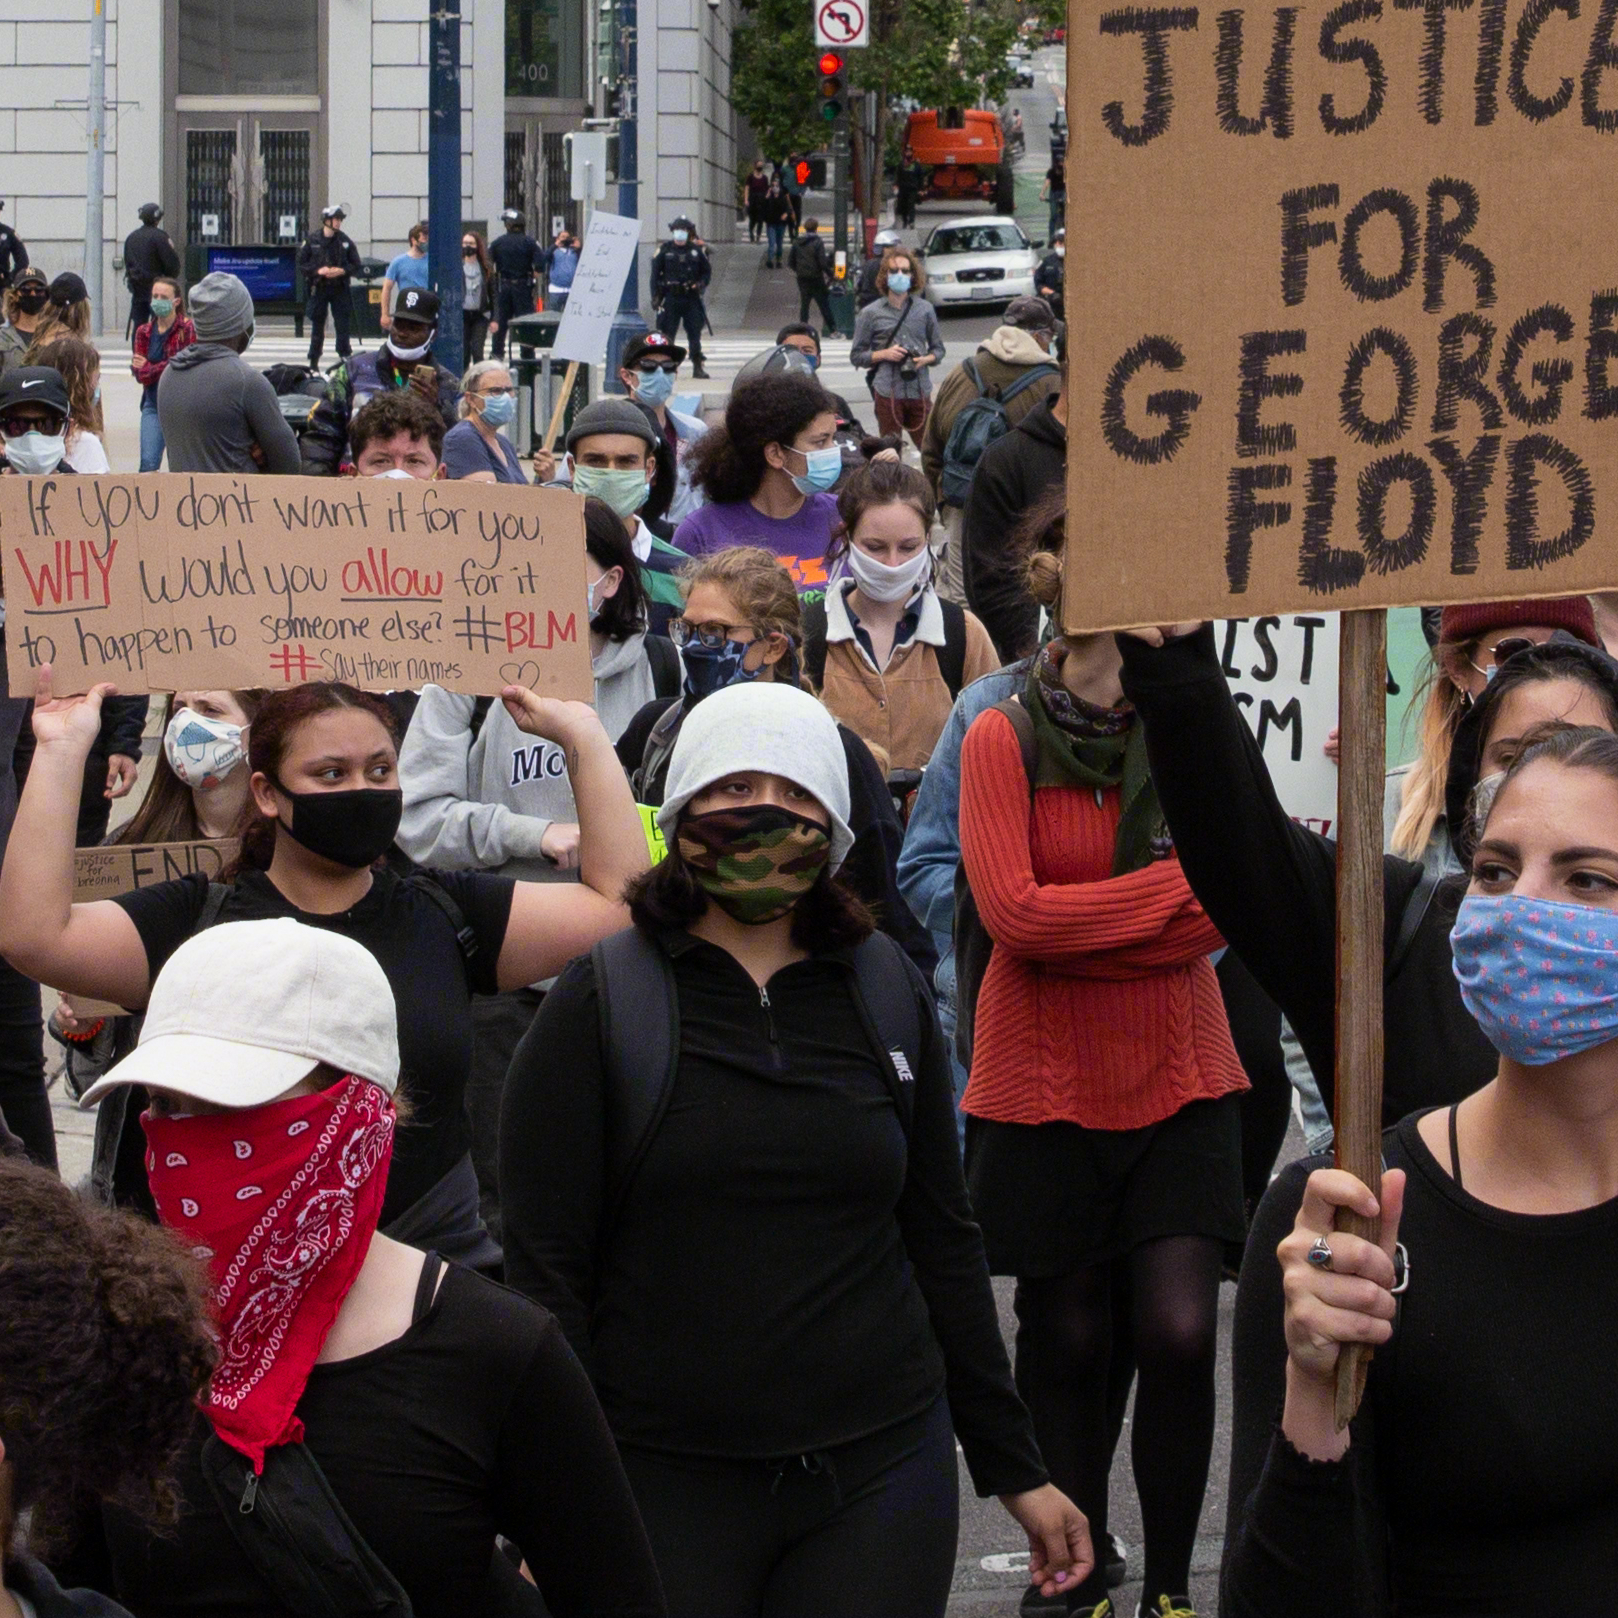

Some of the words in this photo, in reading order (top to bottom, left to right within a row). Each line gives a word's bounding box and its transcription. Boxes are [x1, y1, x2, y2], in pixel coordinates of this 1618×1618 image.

[1278, 174, 1499, 314] FOR
[27, 480, 58, 537] If
[77, 480, 159, 559] you
[176, 476, 260, 531] don't
[274, 491, 371, 531] want
[385, 491, 408, 532] it
[416, 488, 468, 535] for
[478, 508, 544, 570] you,
[1224, 432, 1598, 595] FLOYD
[14, 538, 119, 607] WHY
[139, 539, 257, 604] would
[264, 562, 328, 622] you
[341, 546, 444, 597] allow
[453, 557, 505, 596] for
[509, 560, 539, 595] it
[19, 625, 57, 668] to
[74, 617, 194, 672] happen
[200, 614, 238, 649] to
[261, 611, 371, 645] someone
[381, 610, 443, 645] else?
[452, 604, 578, 655] #BLM
[131, 844, 224, 890] END
[889, 1051, 914, 1081] NIKE
